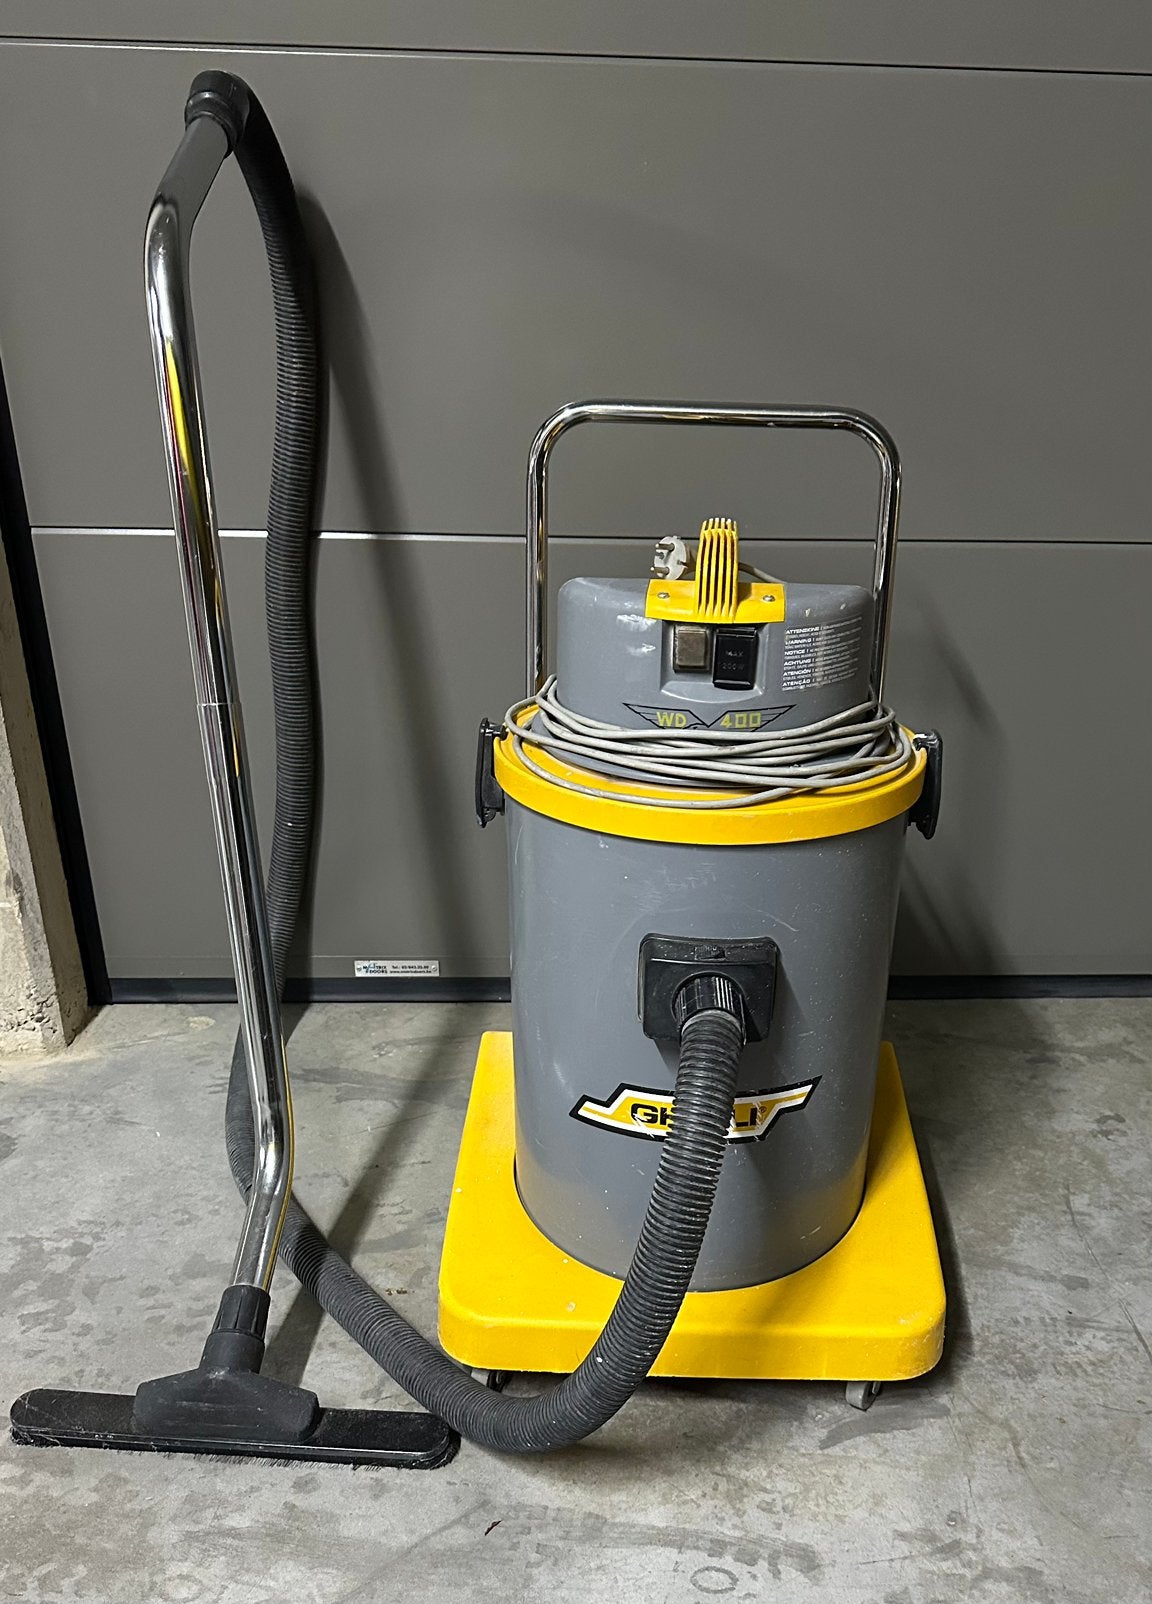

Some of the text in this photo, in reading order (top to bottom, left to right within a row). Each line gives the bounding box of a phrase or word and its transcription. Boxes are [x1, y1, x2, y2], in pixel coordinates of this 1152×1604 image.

[785, 626, 820, 634] ATTENZIONE
[782, 678, 811, 686] ATENÇÃO
[656, 711, 761, 728] WD 400
